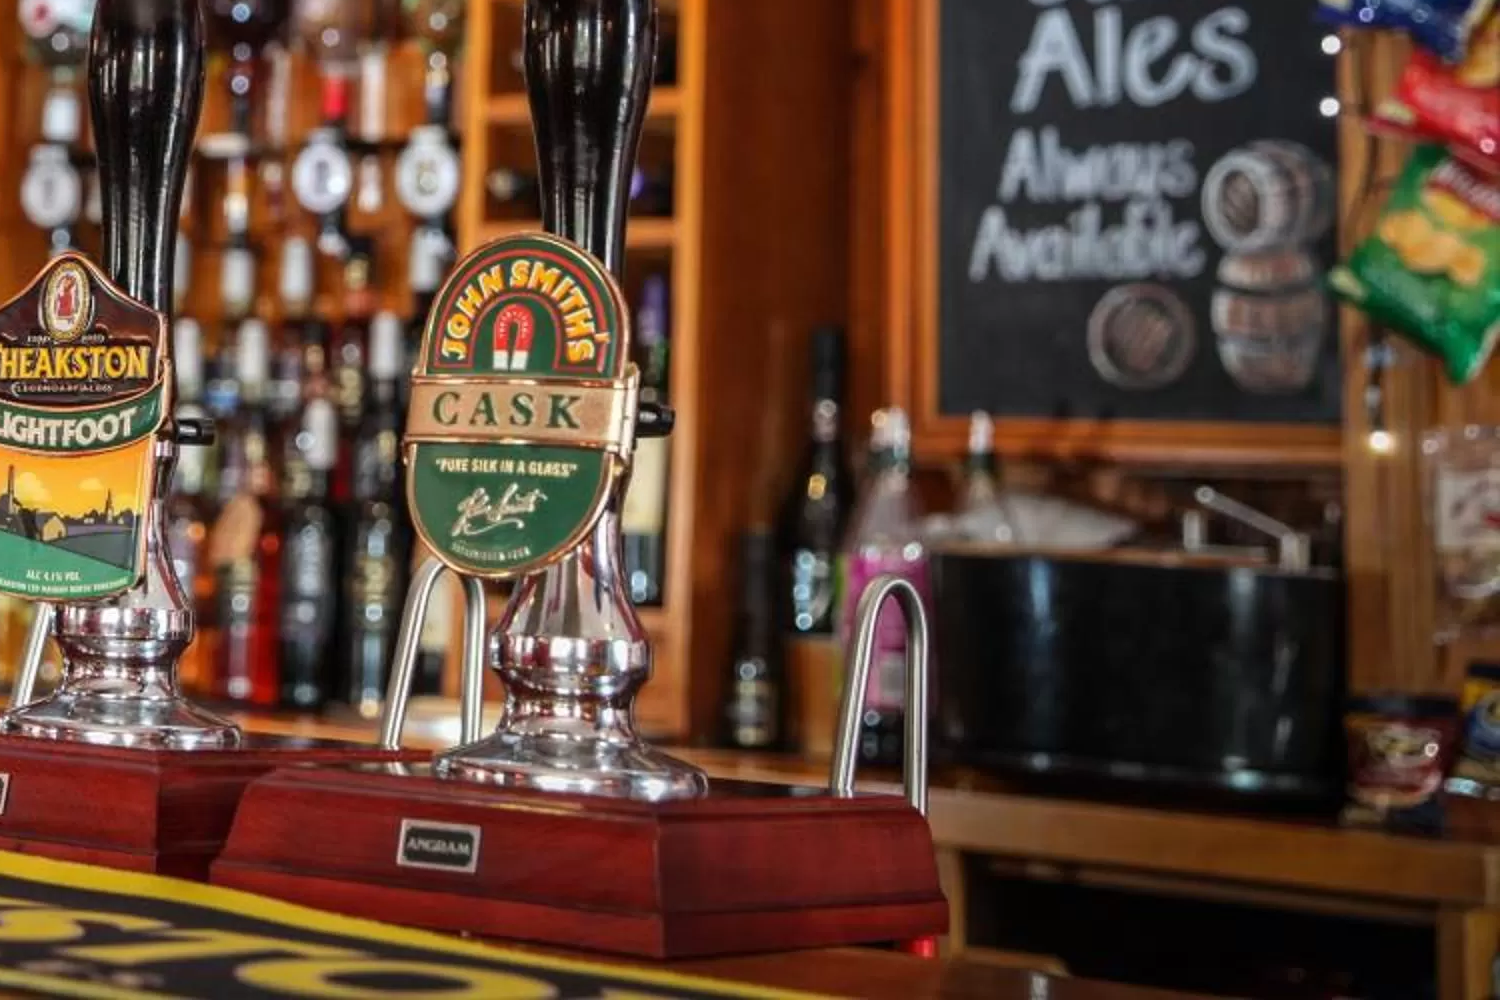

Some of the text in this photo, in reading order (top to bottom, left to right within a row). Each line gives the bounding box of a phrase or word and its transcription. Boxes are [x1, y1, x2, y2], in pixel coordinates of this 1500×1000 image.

[1011, 6, 1255, 113] Ales
[999, 126, 1199, 204] Always
[969, 201, 1204, 281] Available
[441, 259, 611, 366] JOHN SMITH'S
[432, 391, 582, 430] CASK
[471, 458, 498, 473] SILK
[405, 839, 471, 856] ANGRAM
